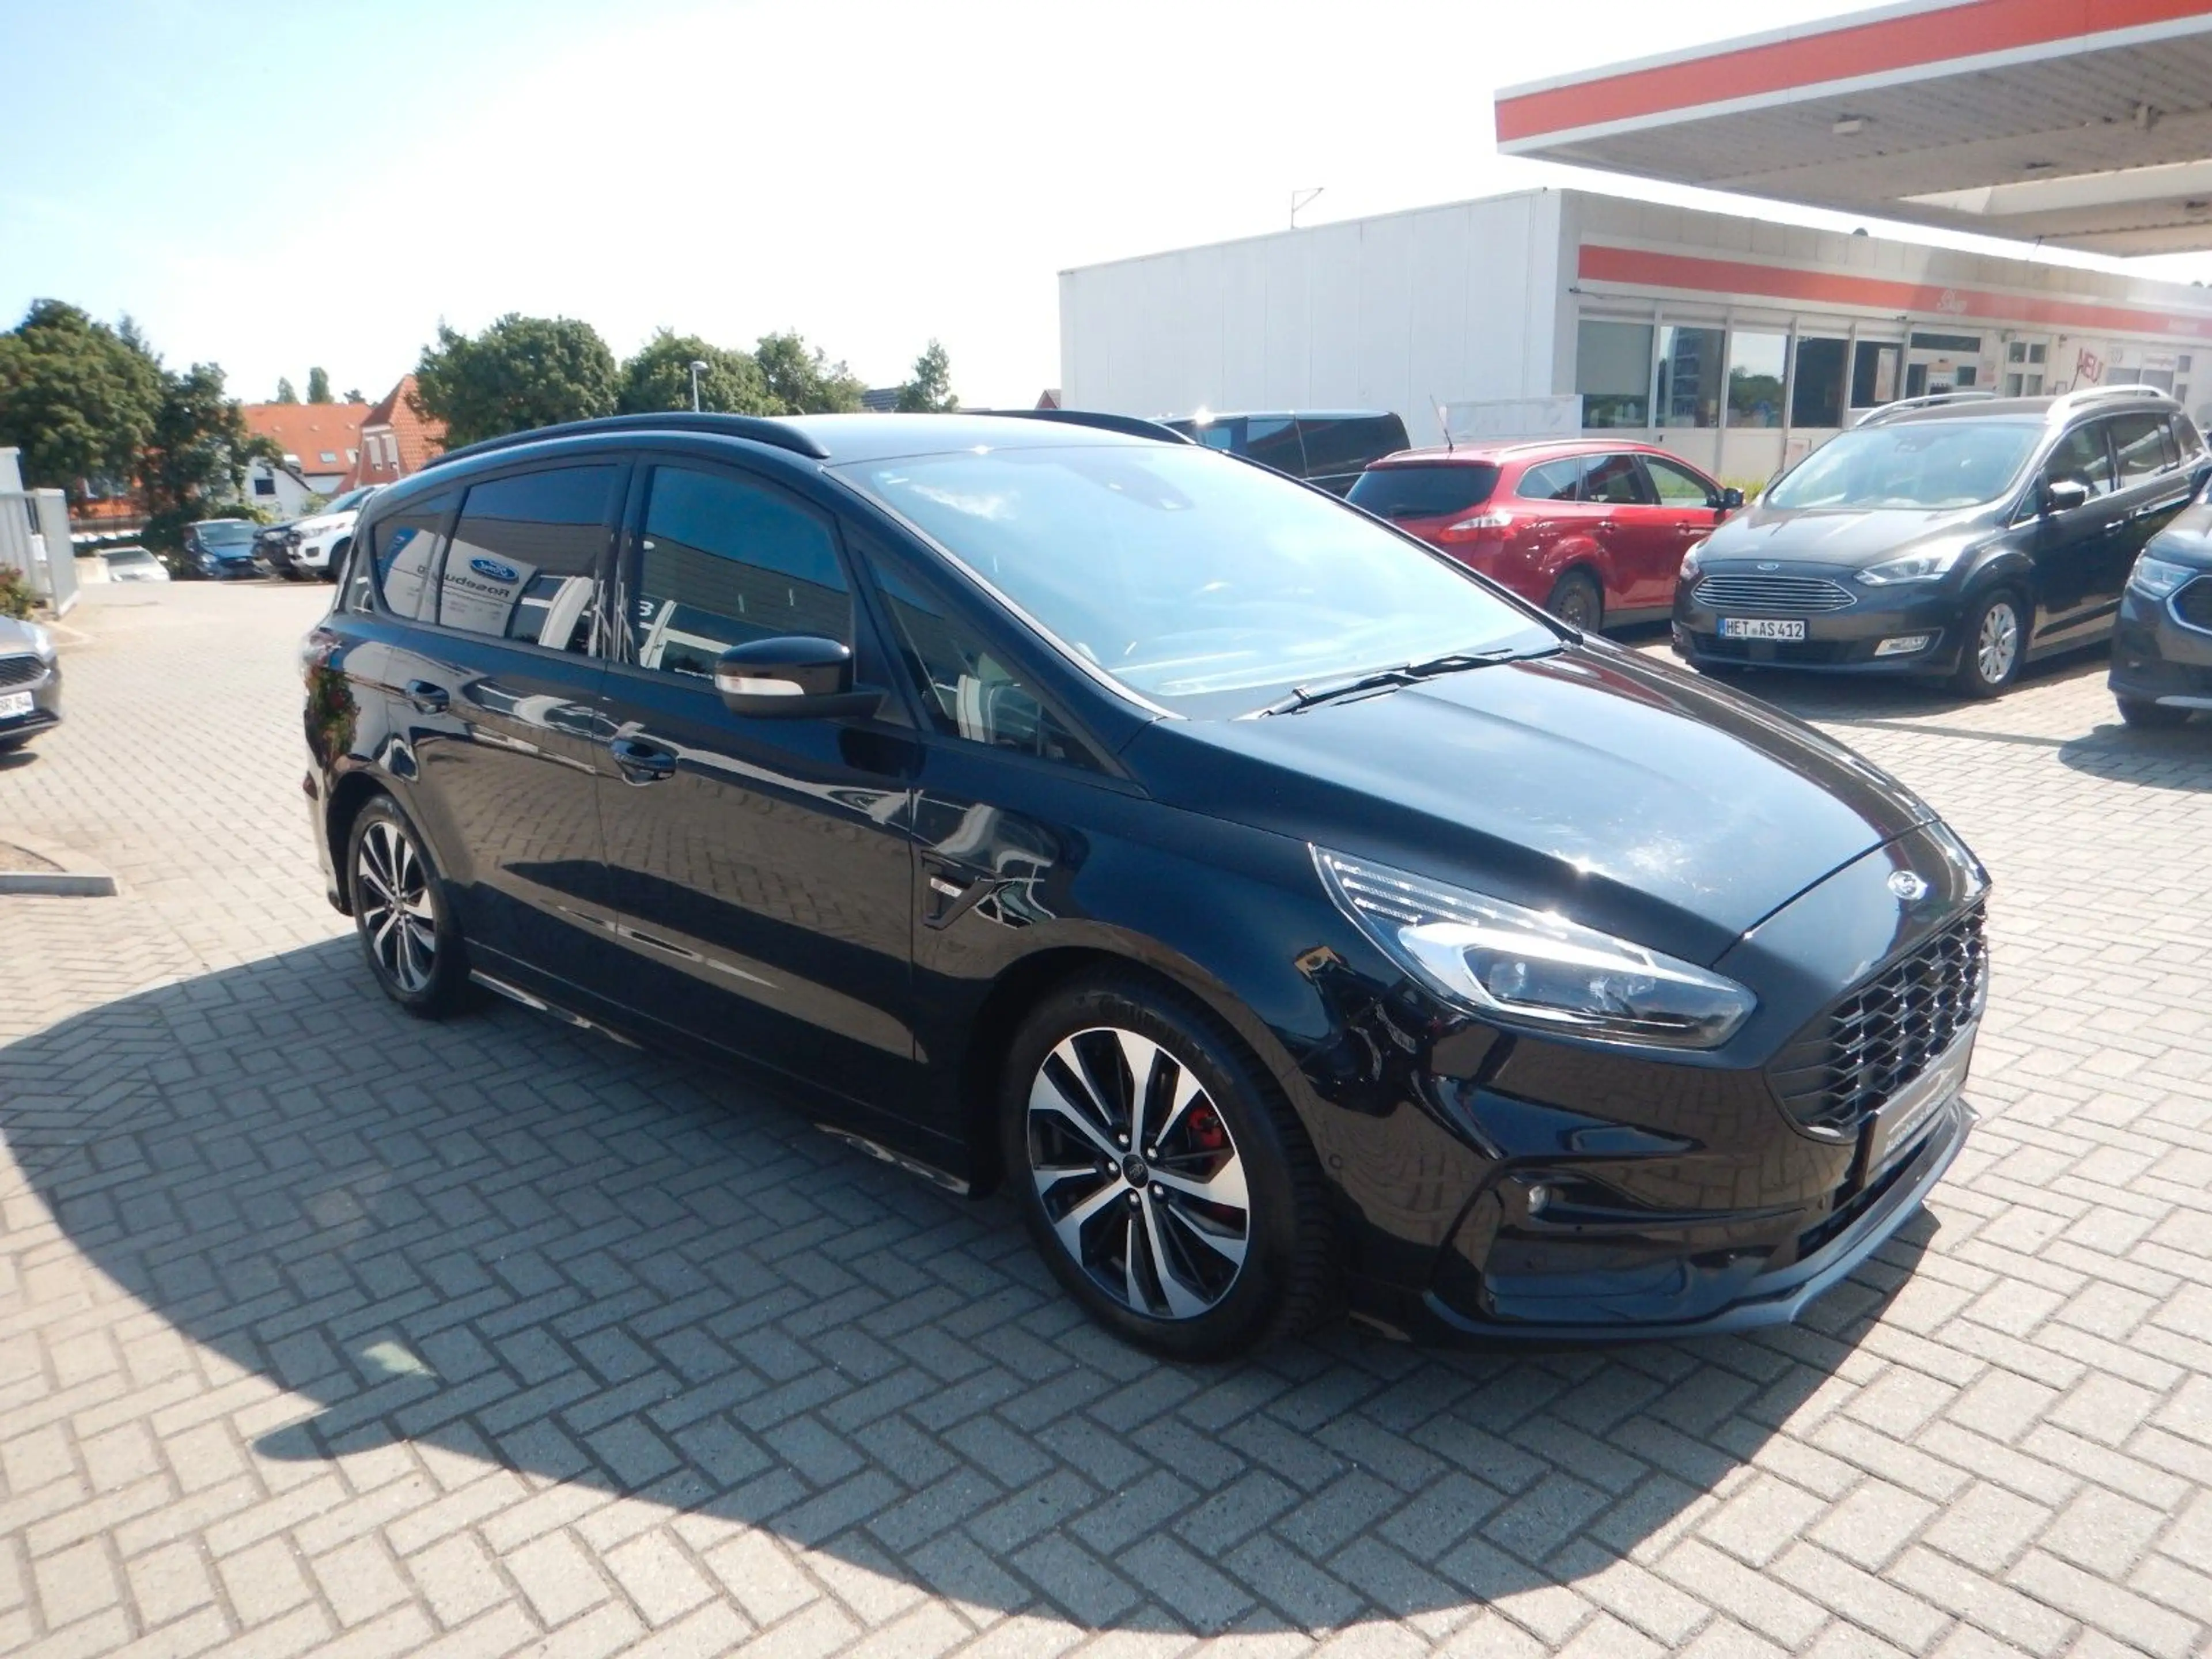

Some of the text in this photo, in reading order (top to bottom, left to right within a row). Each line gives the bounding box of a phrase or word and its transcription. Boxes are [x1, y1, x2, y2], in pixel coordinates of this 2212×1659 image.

[1726, 620, 1802, 638] HET AS 412
